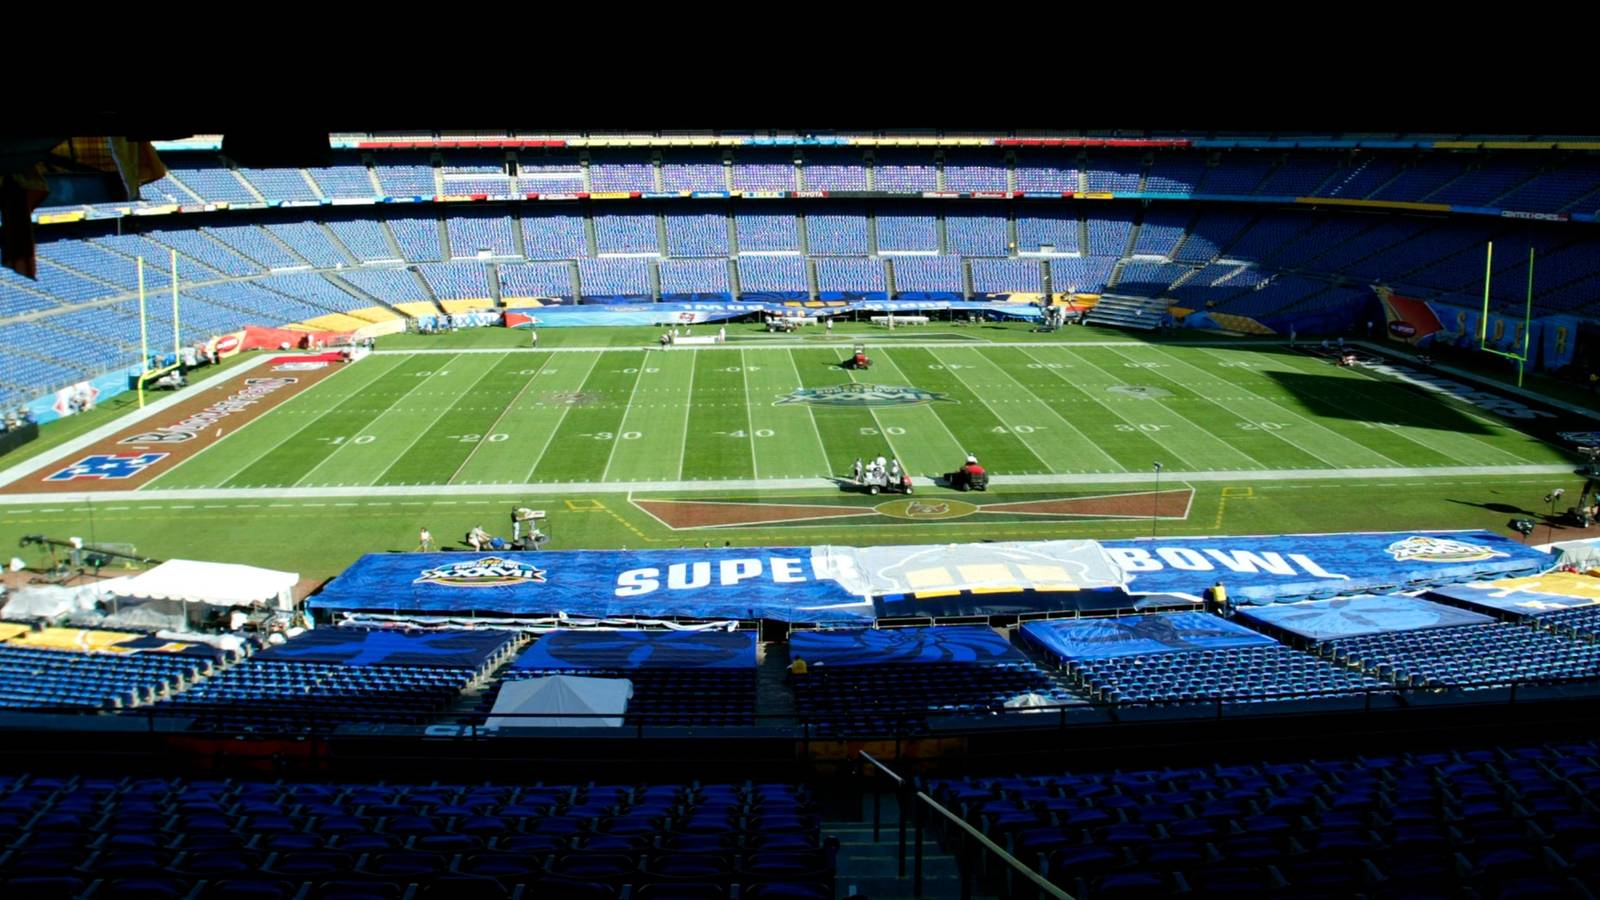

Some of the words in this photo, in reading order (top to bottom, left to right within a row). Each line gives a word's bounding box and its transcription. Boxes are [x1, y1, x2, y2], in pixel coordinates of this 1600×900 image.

[991, 425, 1038, 434] 40
[1114, 424, 1162, 432] 30
[1237, 421, 1284, 430] 20
[594, 431, 642, 441] 30
[726, 429, 775, 438] 40
[859, 427, 907, 436] 50
[331, 435, 376, 445] 10
[457, 433, 510, 443] 20
[614, 553, 861, 597] SUPER
[1107, 546, 1350, 581] BOWL
